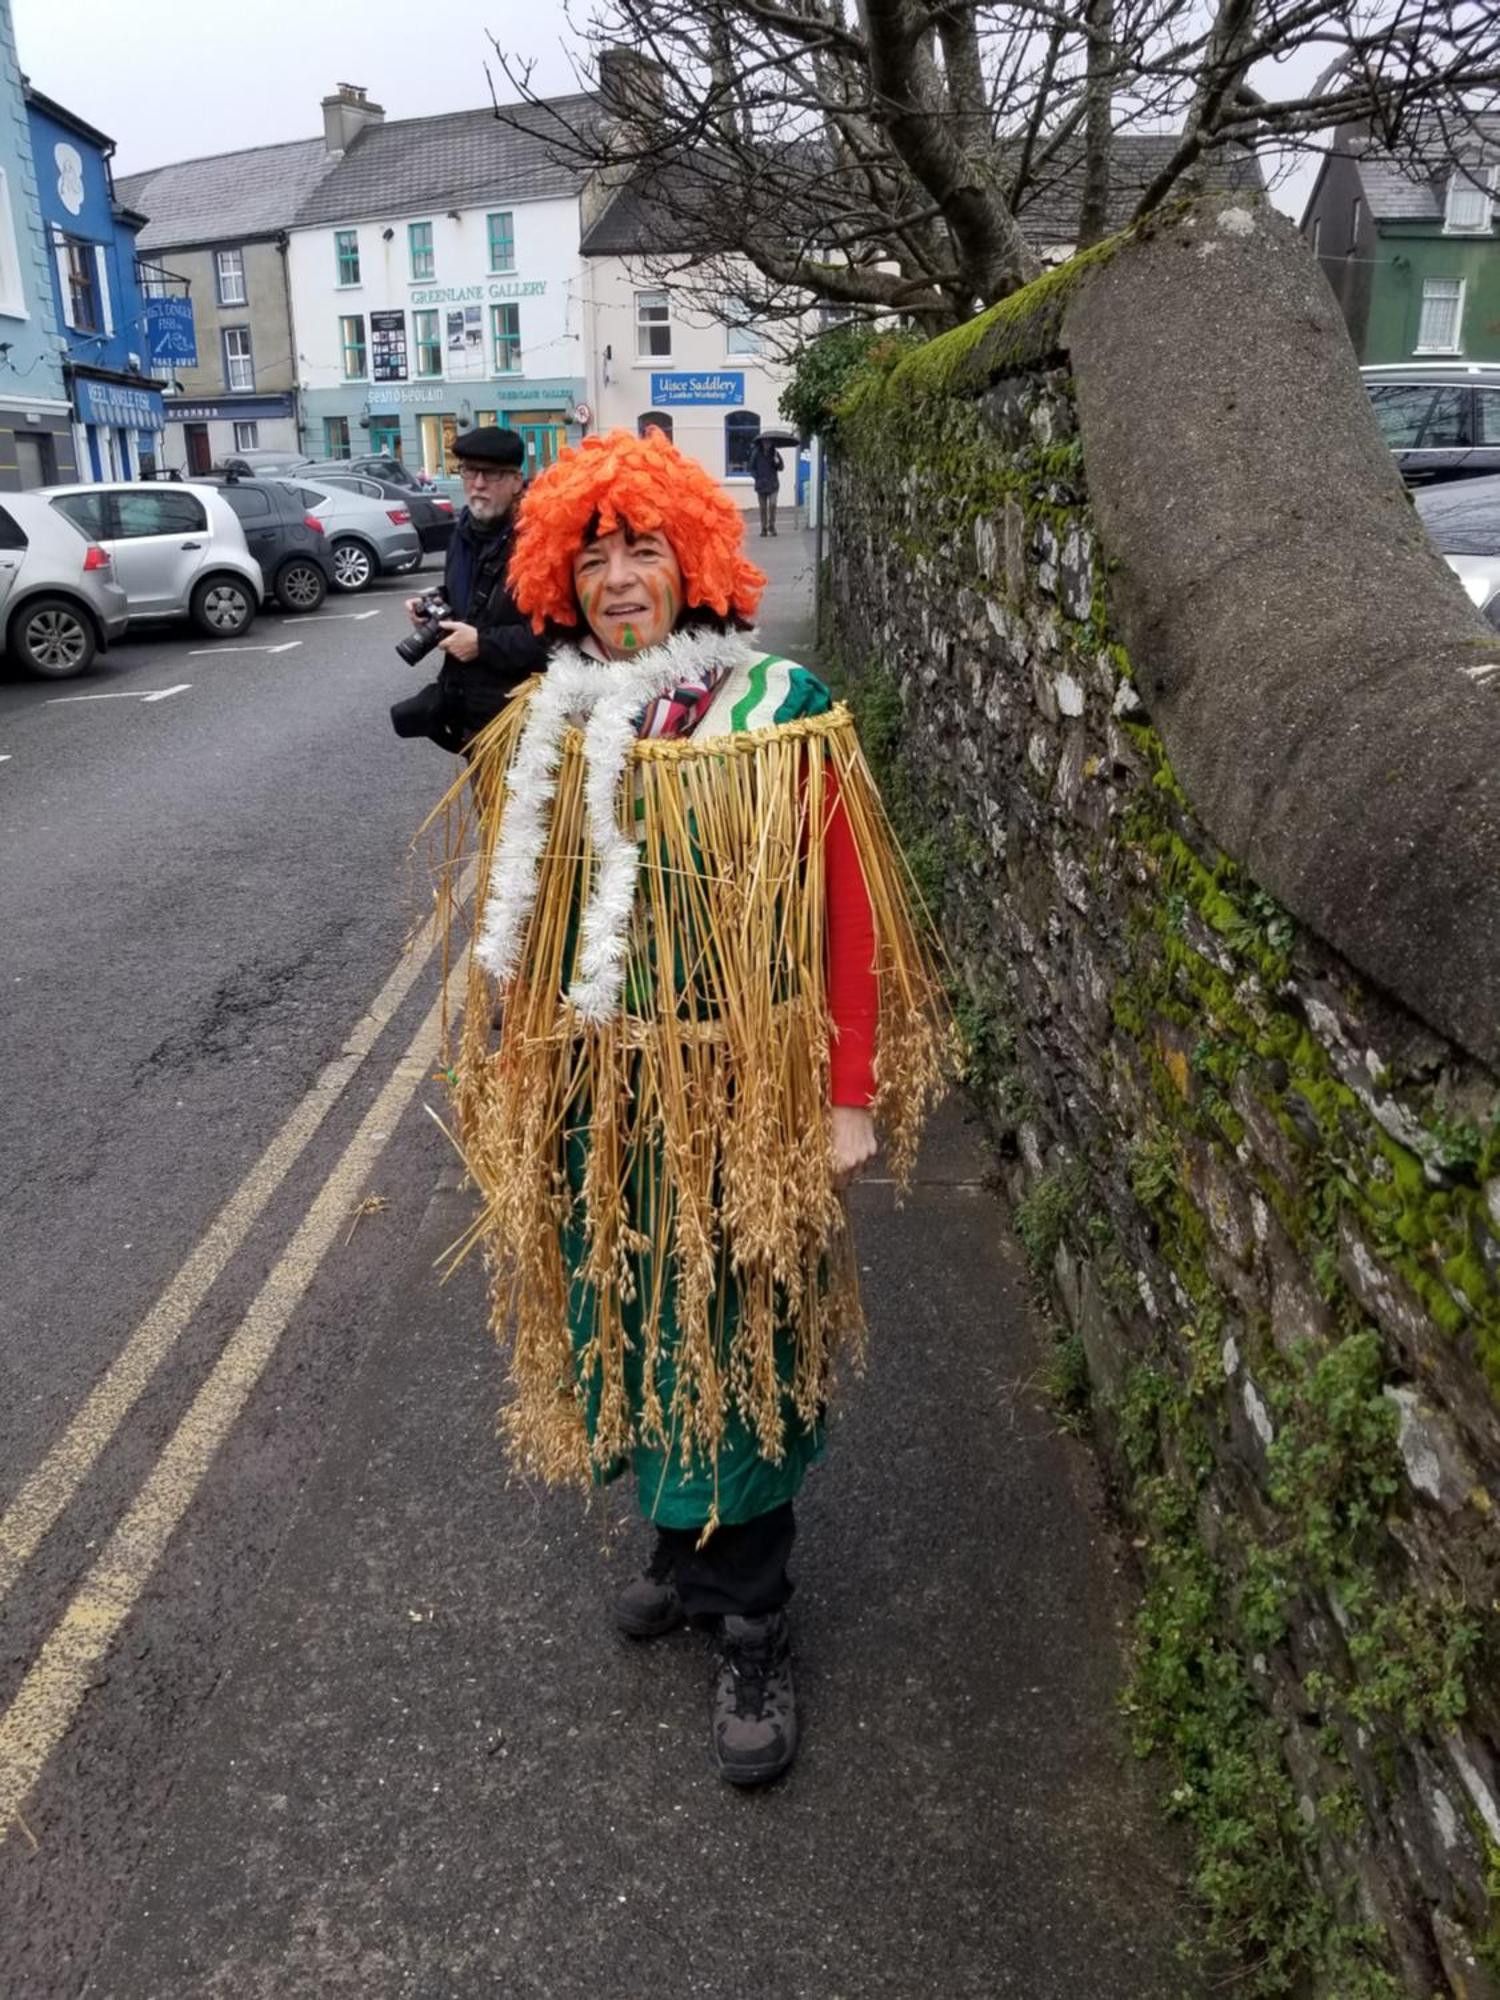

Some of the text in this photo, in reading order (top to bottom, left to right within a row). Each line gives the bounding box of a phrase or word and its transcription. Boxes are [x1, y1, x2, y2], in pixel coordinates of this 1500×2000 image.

[411, 280, 547, 304] GREENLANE GALLERY
[659, 376, 737, 395] Uisce Saddlery
